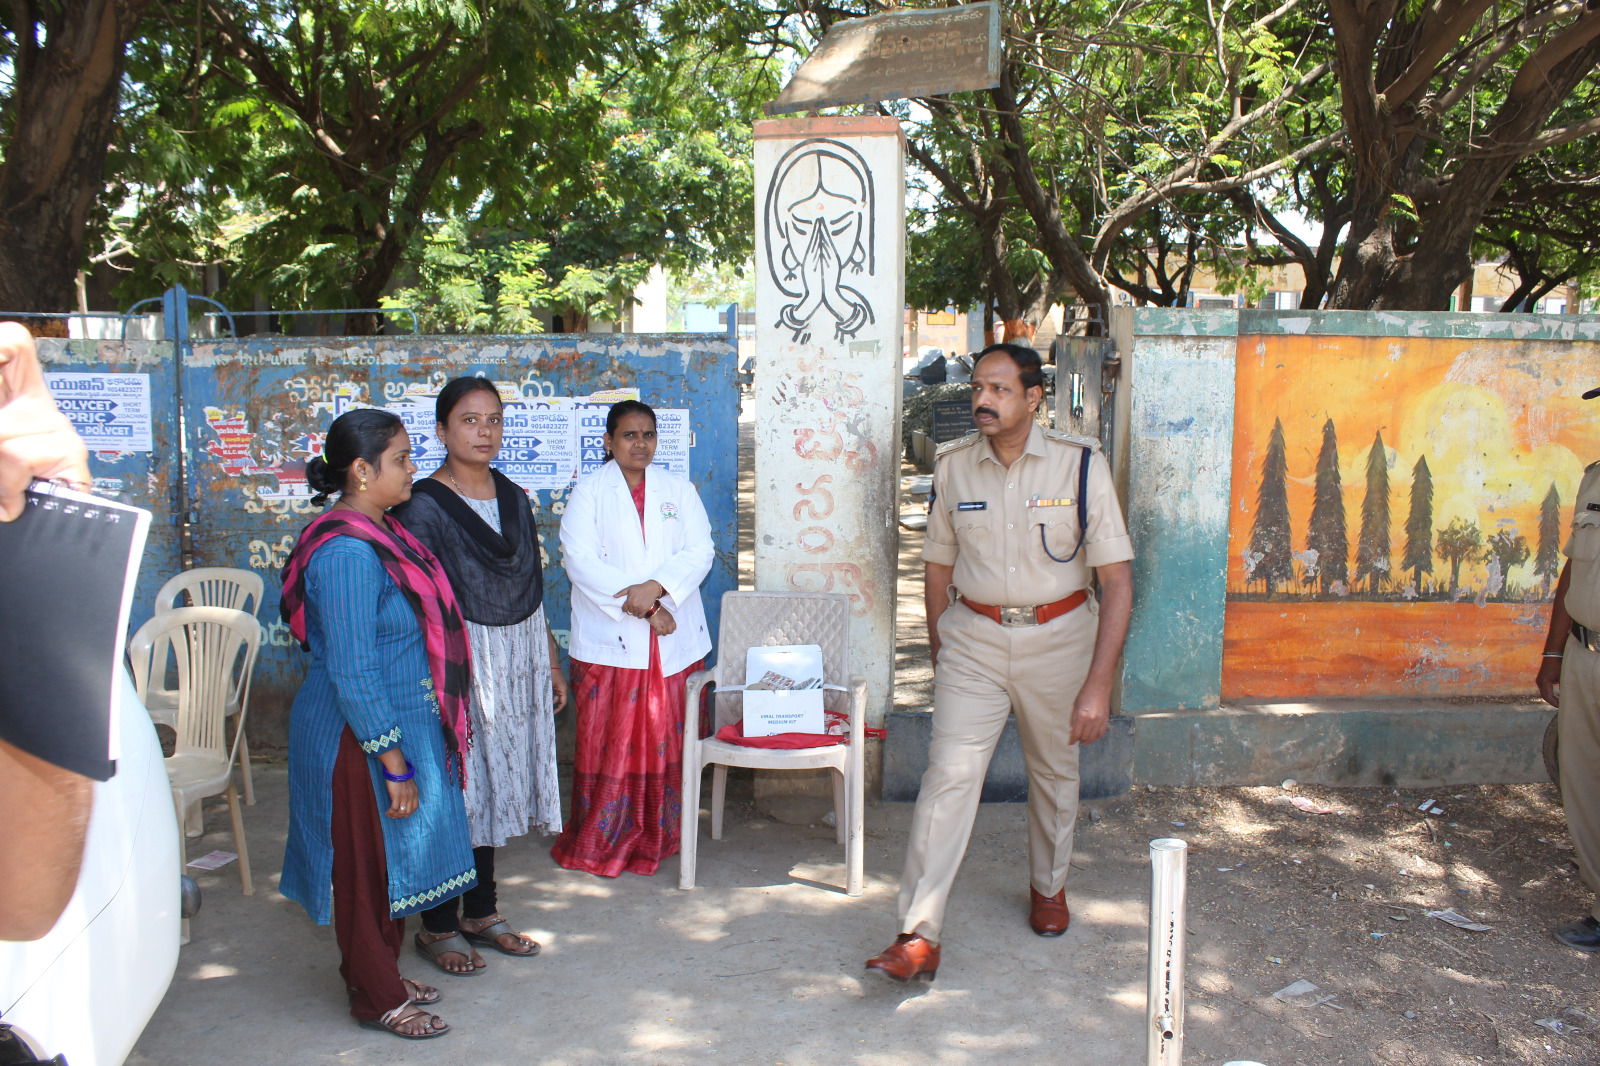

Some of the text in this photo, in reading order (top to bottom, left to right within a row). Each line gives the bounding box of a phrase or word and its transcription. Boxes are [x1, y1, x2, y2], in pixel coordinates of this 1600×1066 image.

[56, 400, 112, 411] POLYCET
[66, 412, 106, 423] PRJC
[85, 426, 130, 436] POLYCET
[502, 437, 535, 448] YCET
[498, 449, 529, 461] RJC
[506, 464, 553, 474] POLYCET
